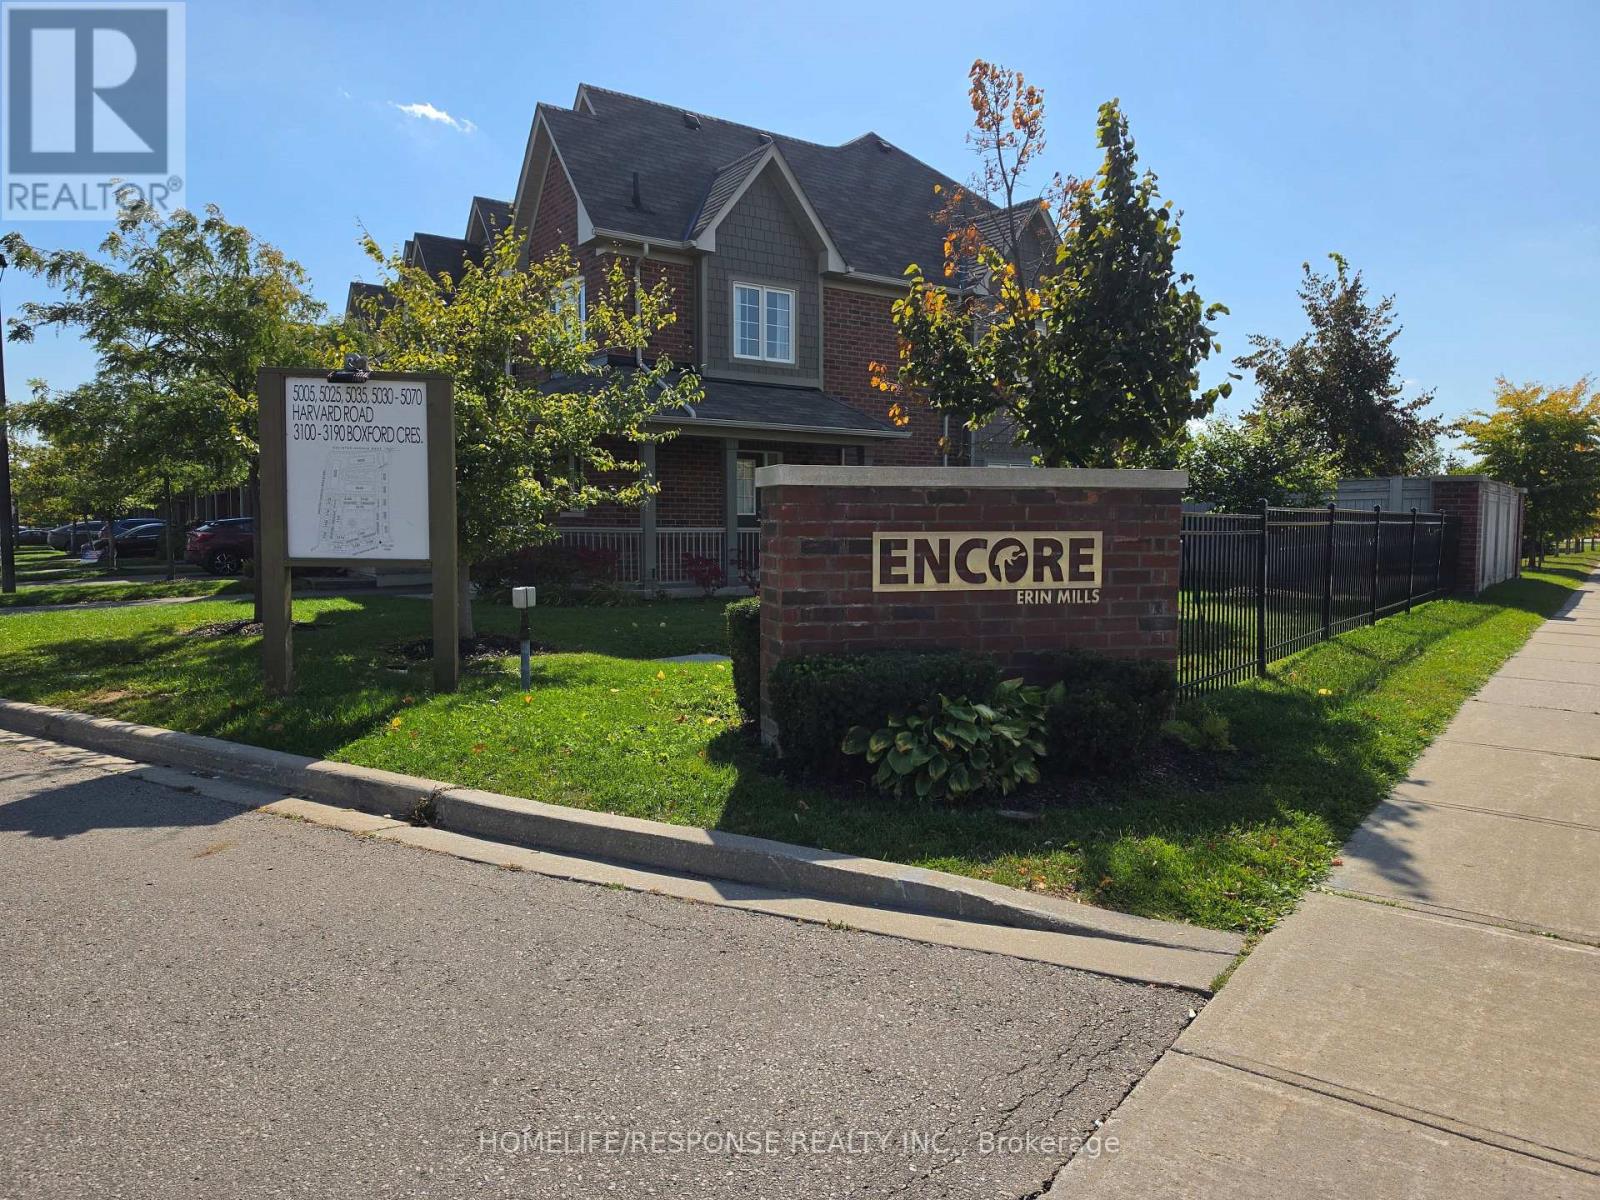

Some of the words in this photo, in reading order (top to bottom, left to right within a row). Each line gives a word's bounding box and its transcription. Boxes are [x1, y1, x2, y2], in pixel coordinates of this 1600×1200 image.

[293, 384, 317, 403] 5005,
[319, 385, 343, 404] 5025,
[345, 386, 369, 404] 5035,
[372, 387, 394, 405] 5030
[400, 388, 423, 406] 5070
[292, 404, 342, 422] HARVARD
[344, 405, 374, 423] ROAD
[293, 423, 317, 441] 3100
[323, 424, 346, 442] 3190
[347, 425, 395, 443] BOXFORD
[397, 426, 424, 444] CRES.
[879, 537, 1096, 585] ENCORE
[1016, 590, 1052, 605] ERIN
[1056, 588, 1100, 604] MILLS
